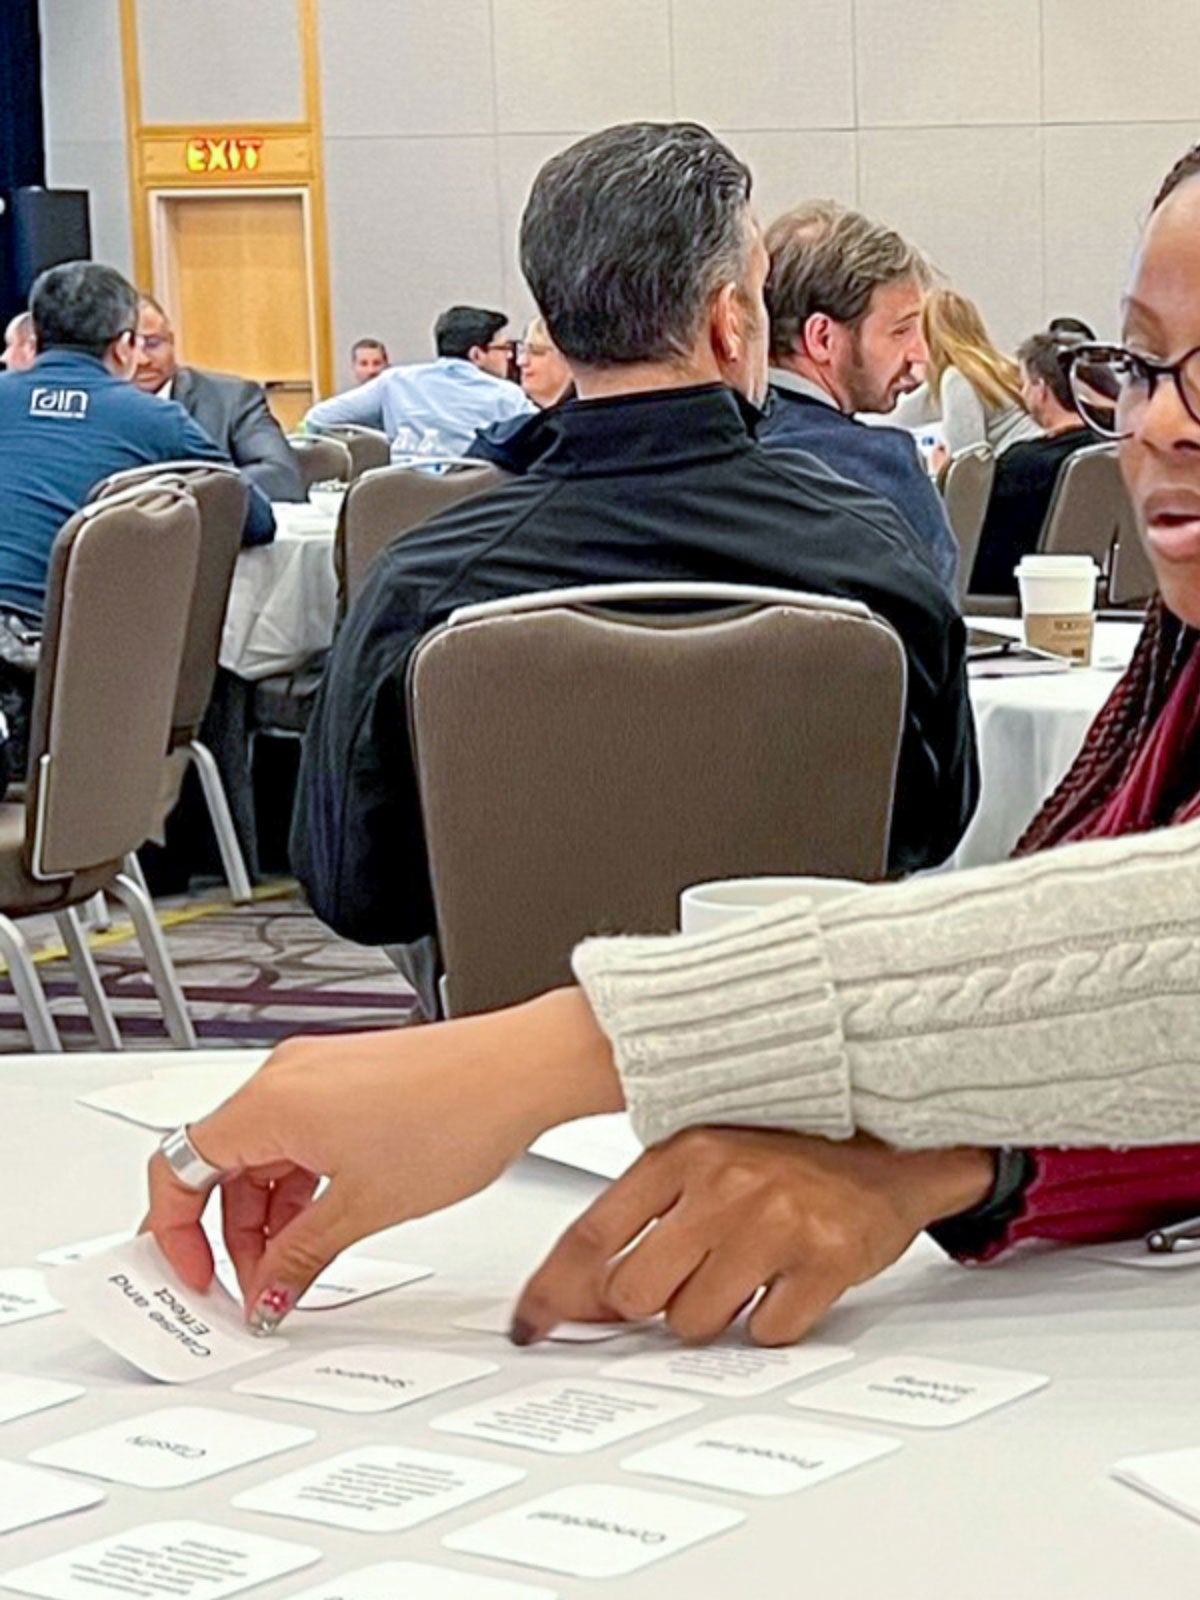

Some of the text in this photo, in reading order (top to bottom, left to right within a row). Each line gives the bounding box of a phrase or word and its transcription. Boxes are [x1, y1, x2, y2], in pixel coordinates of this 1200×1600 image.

[185, 137, 262, 171] EXIT
[31, 388, 88, 411] rain
[108, 1273, 211, 1358] Cause and
[152, 1288, 211, 1337] Effect
